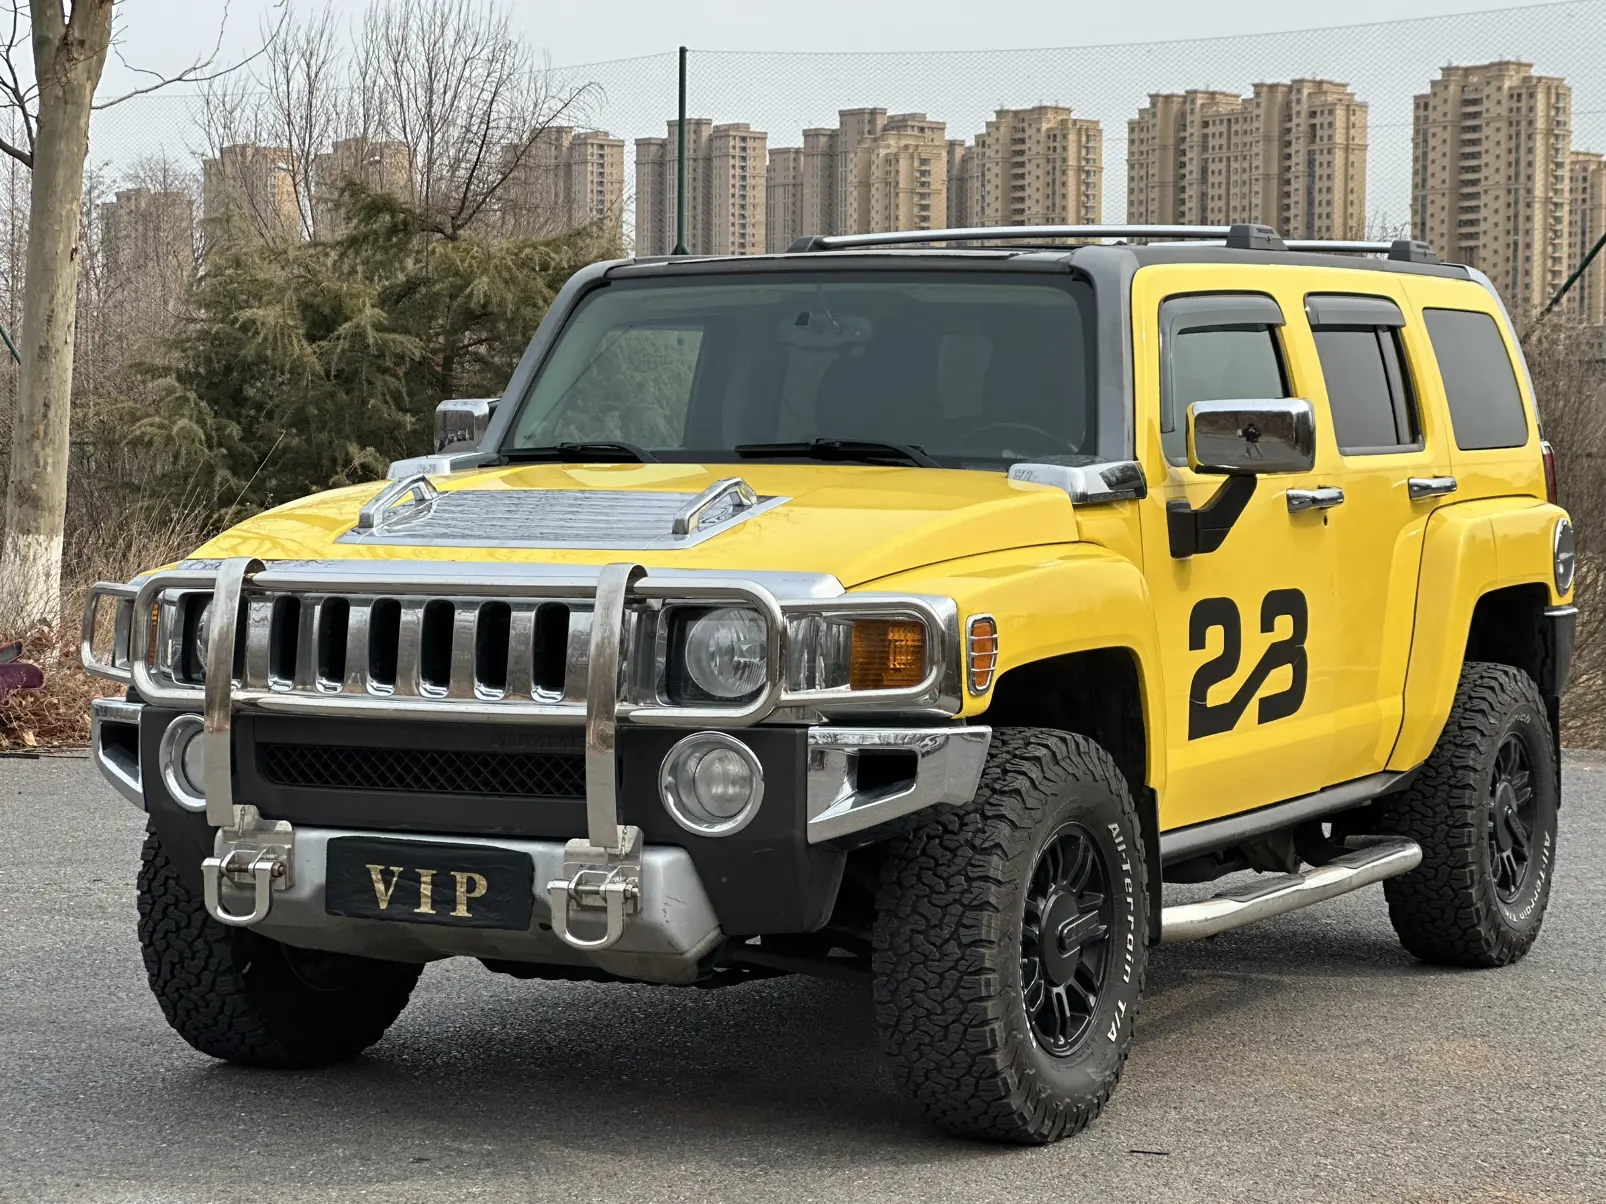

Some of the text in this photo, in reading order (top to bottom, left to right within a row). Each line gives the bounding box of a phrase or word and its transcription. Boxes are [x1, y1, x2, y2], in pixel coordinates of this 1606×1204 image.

[1188, 588, 1308, 741] 23
[365, 864, 488, 917] VIP
[1106, 823, 1134, 1042] All-Terrain T/A
[1519, 831, 1551, 920] All-Terrain
